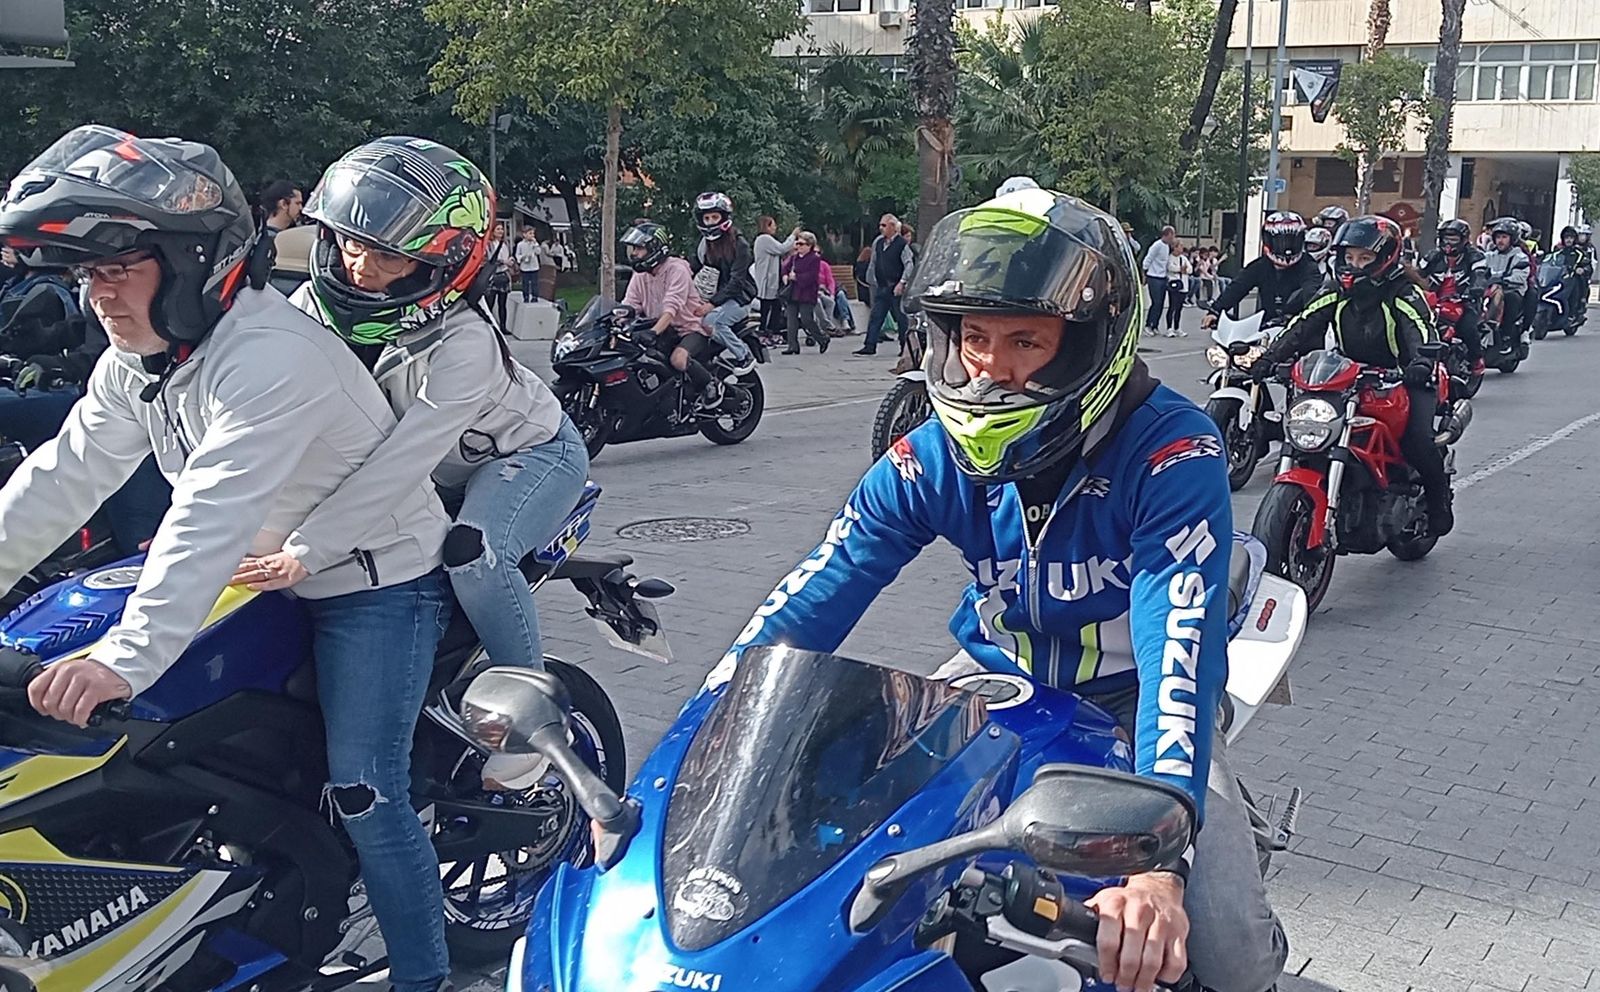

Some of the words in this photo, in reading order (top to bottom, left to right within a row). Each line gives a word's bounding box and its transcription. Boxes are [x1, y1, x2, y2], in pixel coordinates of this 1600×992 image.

[977, 553, 1132, 602] UZUK
[1153, 571, 1206, 778] SUZUKI
[26, 885, 149, 961] YAMAHA
